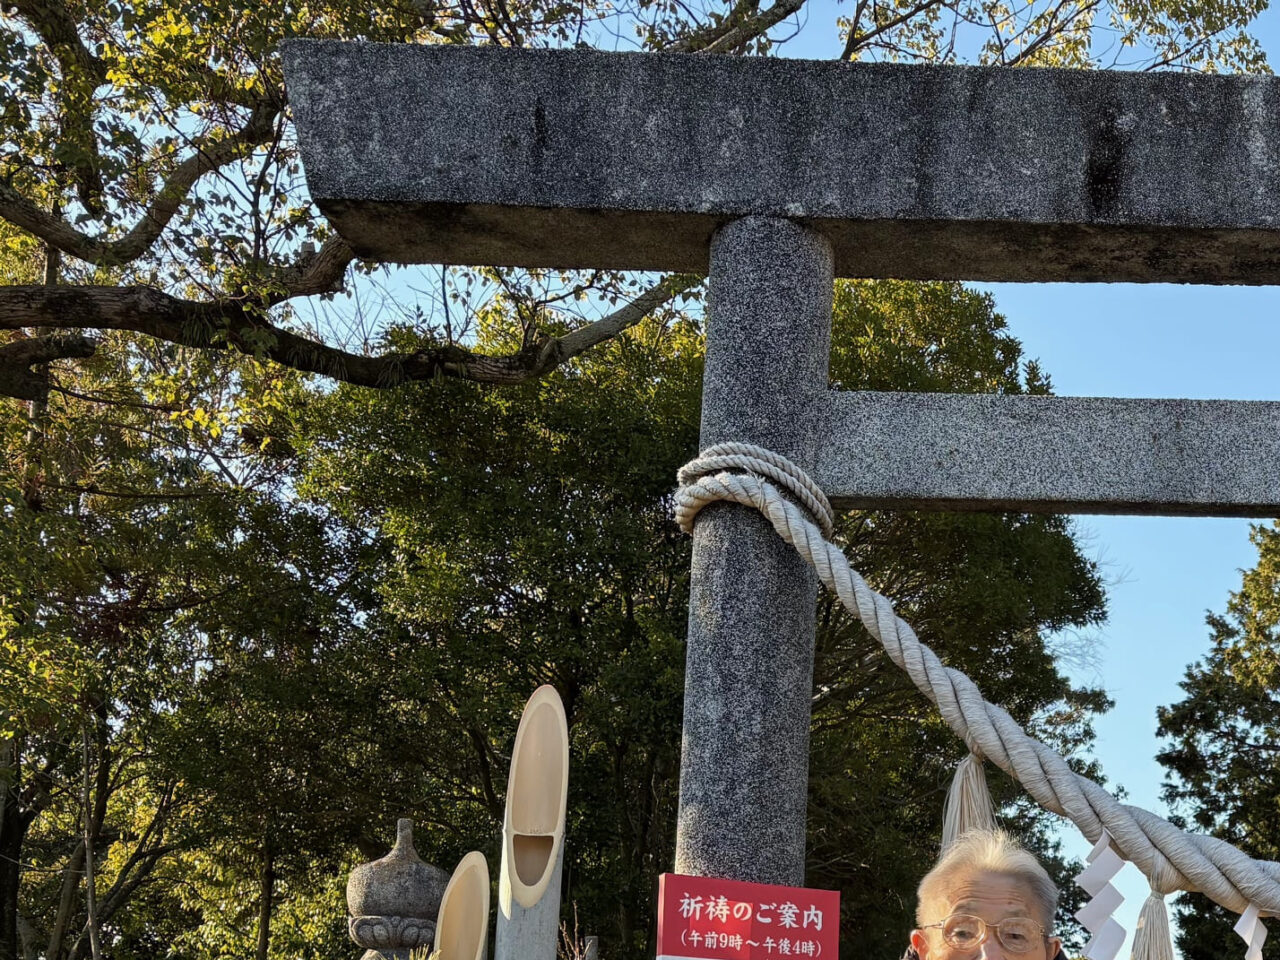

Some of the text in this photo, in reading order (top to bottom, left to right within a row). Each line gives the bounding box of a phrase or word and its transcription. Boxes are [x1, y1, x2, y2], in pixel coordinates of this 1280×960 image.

[678, 892, 823, 931] 祈祷のご案内
